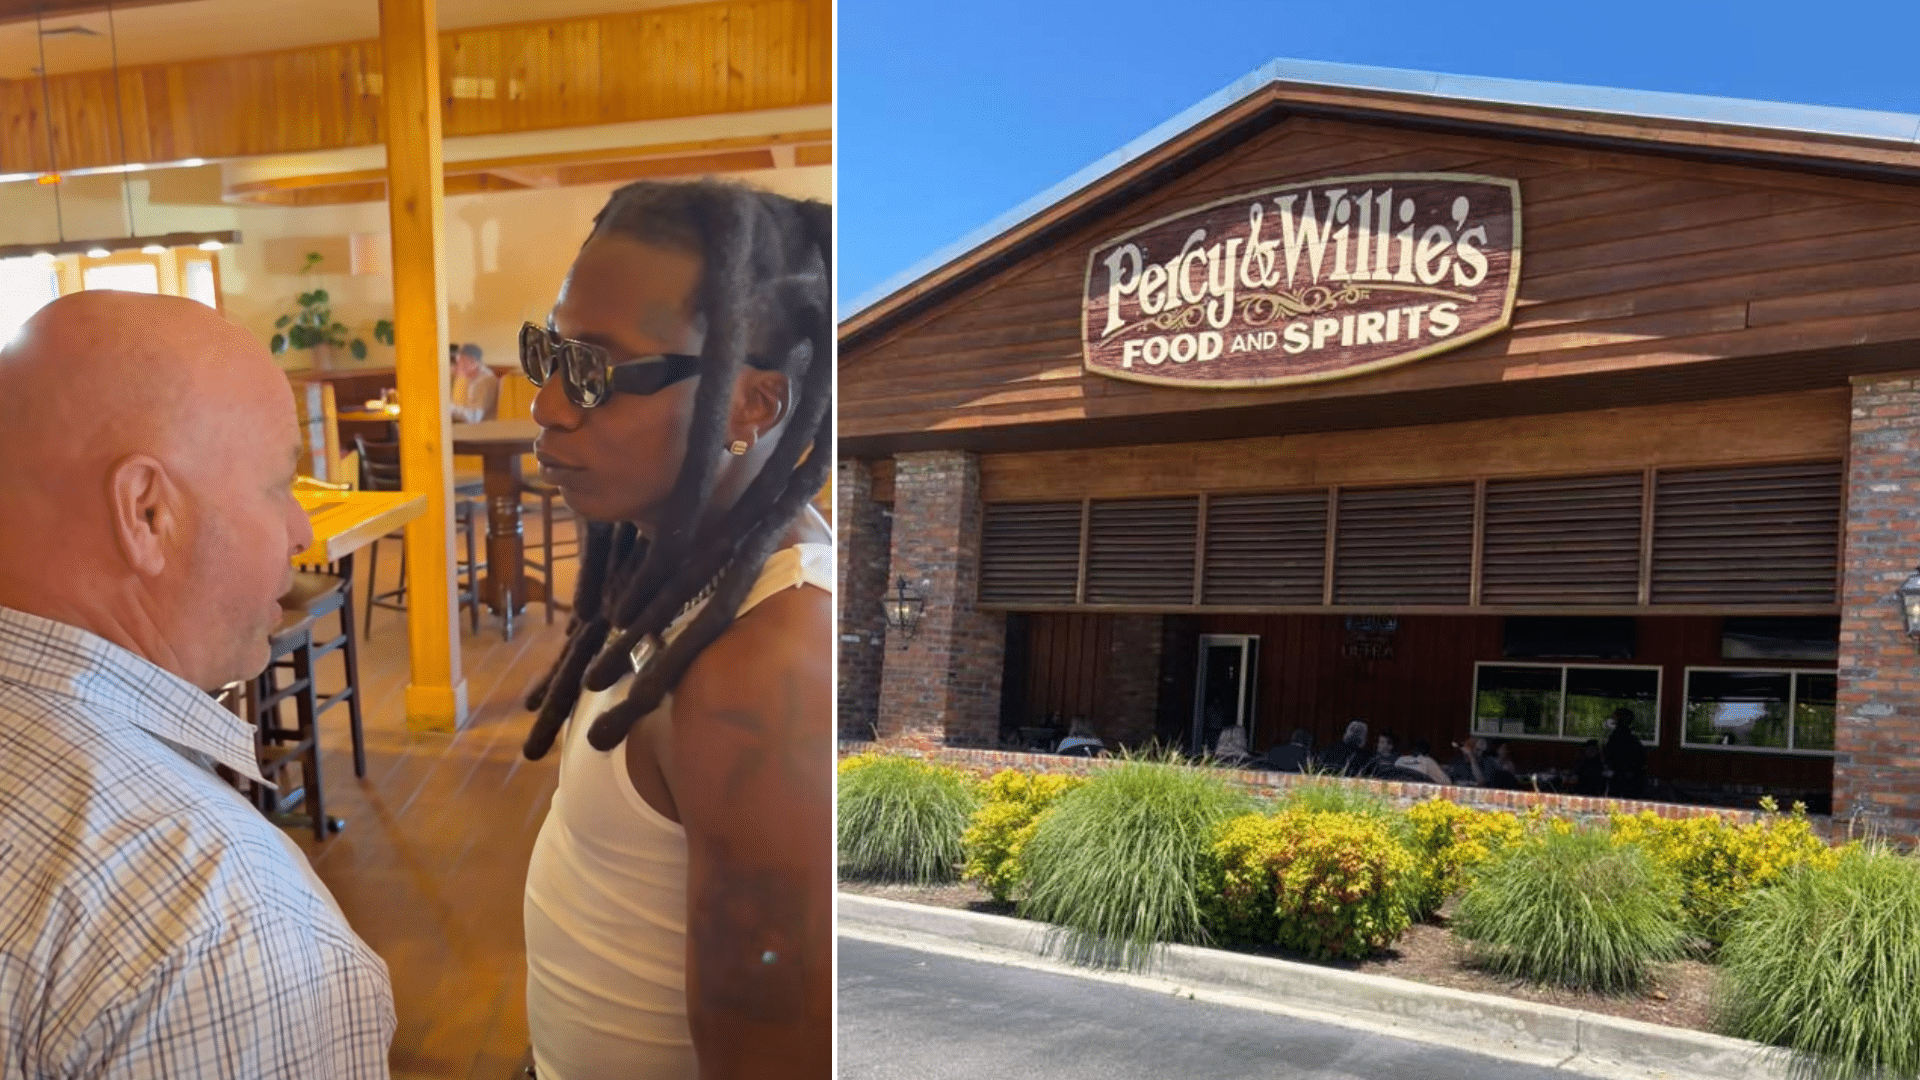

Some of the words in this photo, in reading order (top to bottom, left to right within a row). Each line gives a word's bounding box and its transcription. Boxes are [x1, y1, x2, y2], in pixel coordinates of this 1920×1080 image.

[1101, 229, 1243, 337] Percy
[1240, 203, 1280, 288] &
[1274, 187, 1488, 288] Willie's
[1122, 331, 1223, 368] FOOD
[1230, 331, 1278, 353] AND
[1282, 302, 1460, 354] SPIRITS
